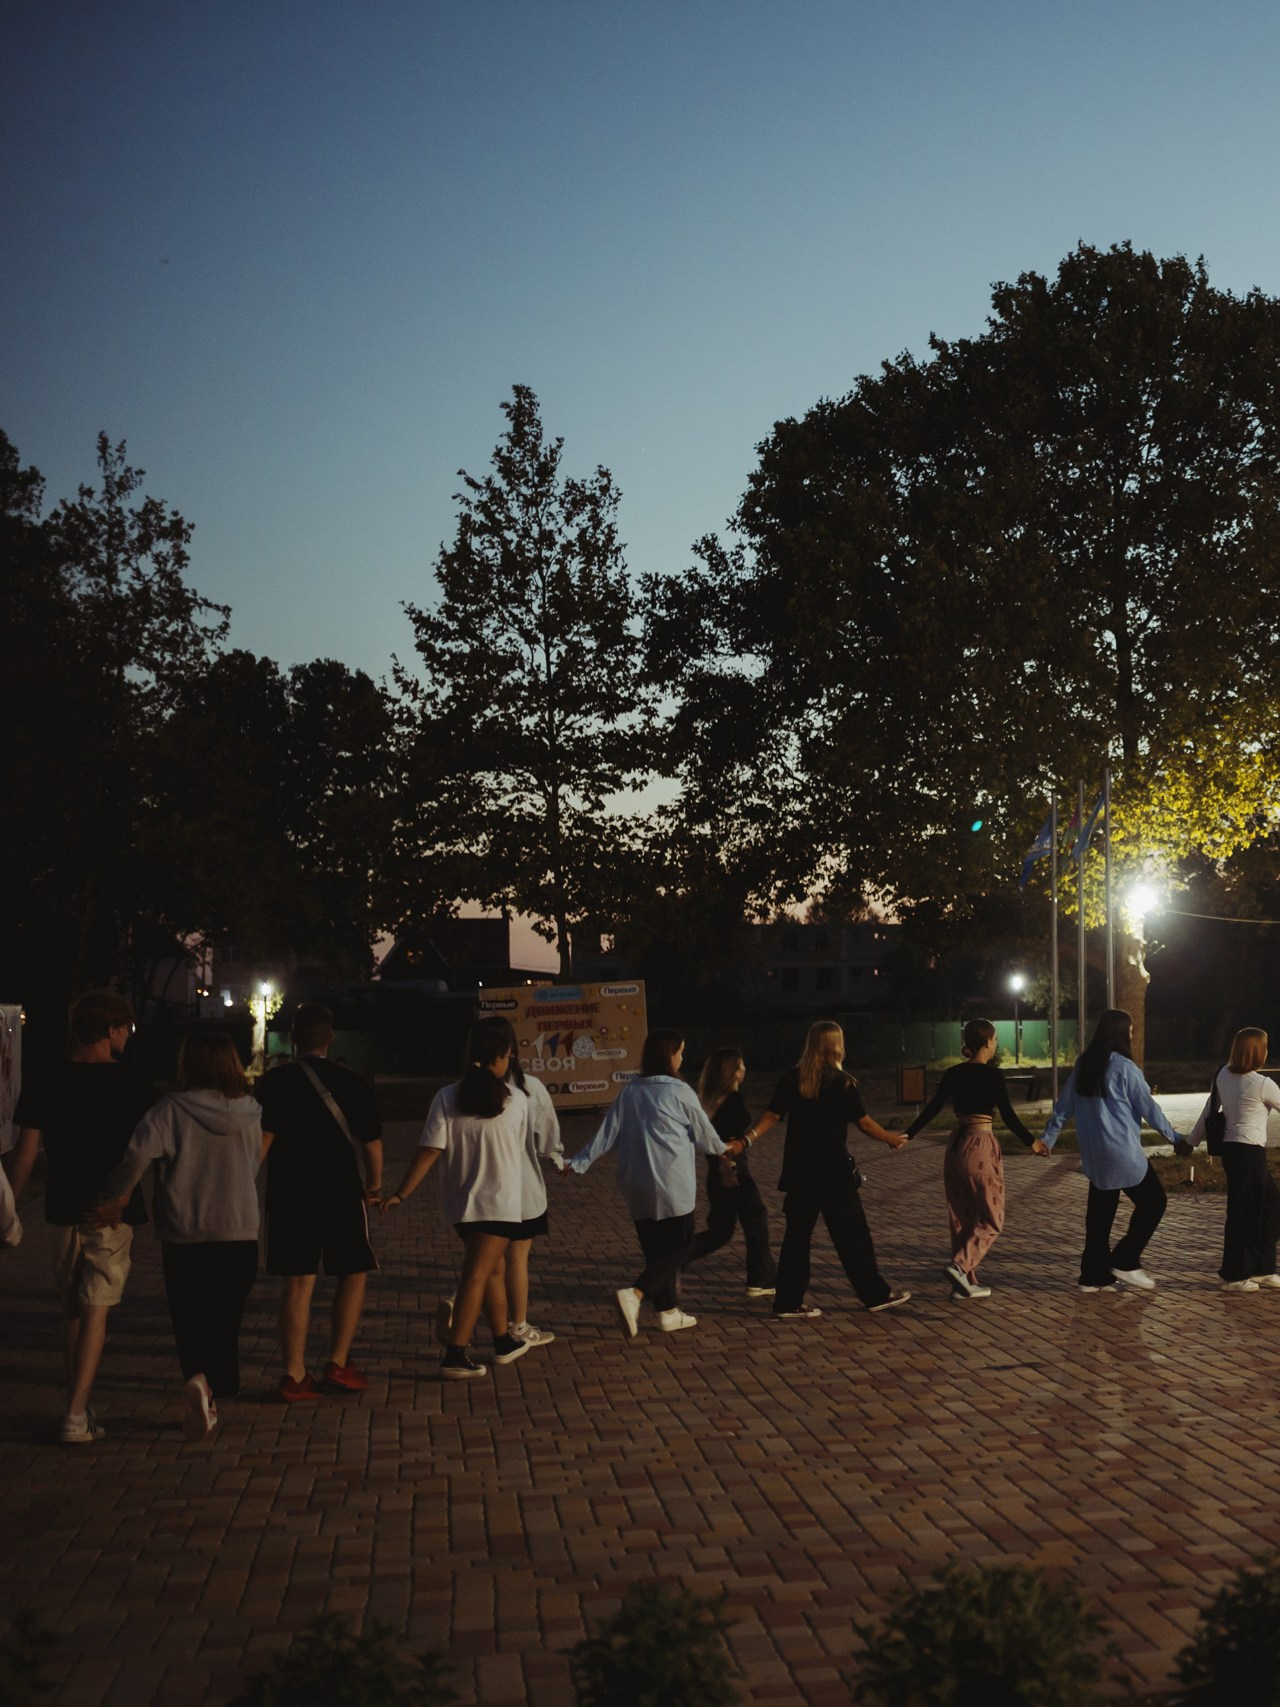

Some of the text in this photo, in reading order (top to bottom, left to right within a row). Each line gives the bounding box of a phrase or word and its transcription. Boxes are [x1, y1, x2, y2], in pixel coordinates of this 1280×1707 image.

[603, 986, 637, 995] Первые
[481, 1001, 516, 1010] Первые
[525, 1002, 601, 1018] ДВИЖЕНИЕ
[538, 1019, 594, 1031] ПЕРВЫХ
[572, 1082, 606, 1092] Первые
